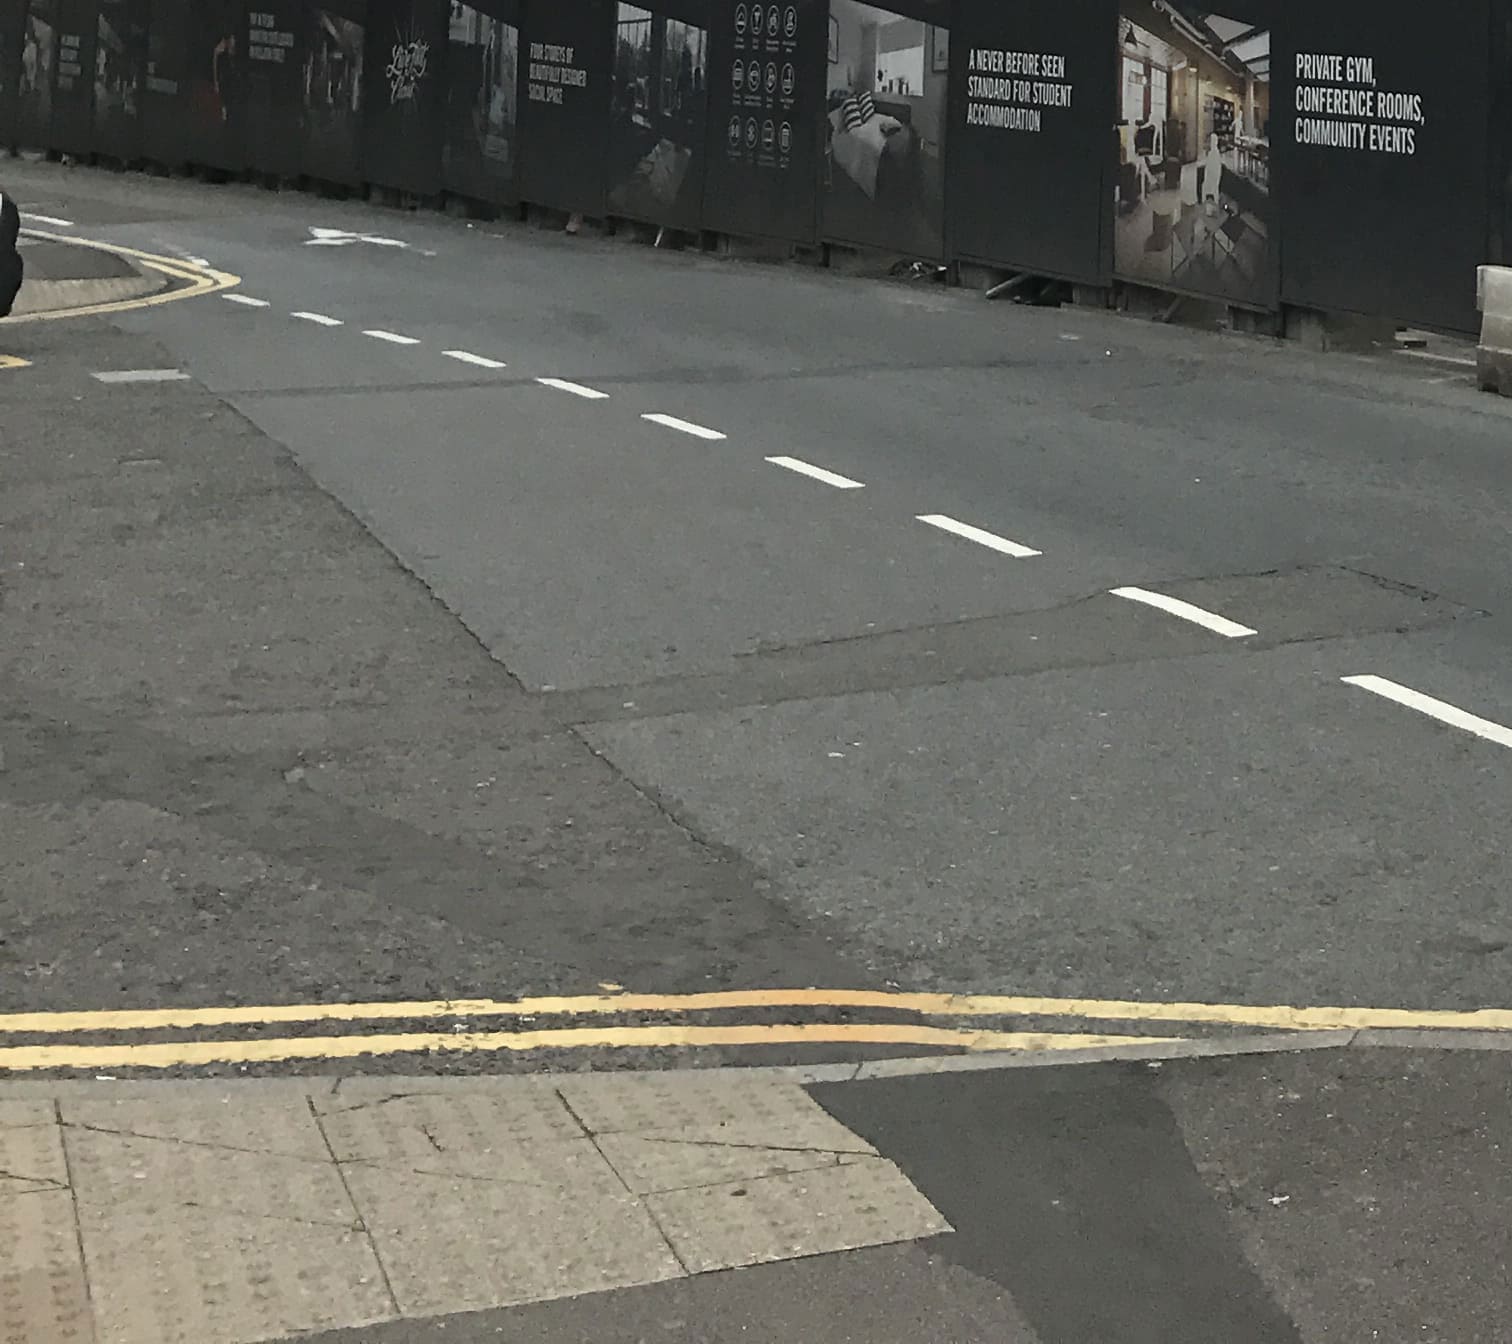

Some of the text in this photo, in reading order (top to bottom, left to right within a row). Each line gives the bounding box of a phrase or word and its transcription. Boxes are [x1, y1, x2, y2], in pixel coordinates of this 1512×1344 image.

[968, 48, 1065, 78] A NEVER BEFORE SEEN
[1296, 53, 1376, 87] PRIVATE GYM,
[968, 75, 1072, 107] STANDARD FOR STUDENT
[1295, 85, 1425, 126] CONFERENCE ROOMS,
[967, 102, 1041, 132] ACCOMMODATION
[1295, 117, 1415, 155] COMMUNITY EVENTS
